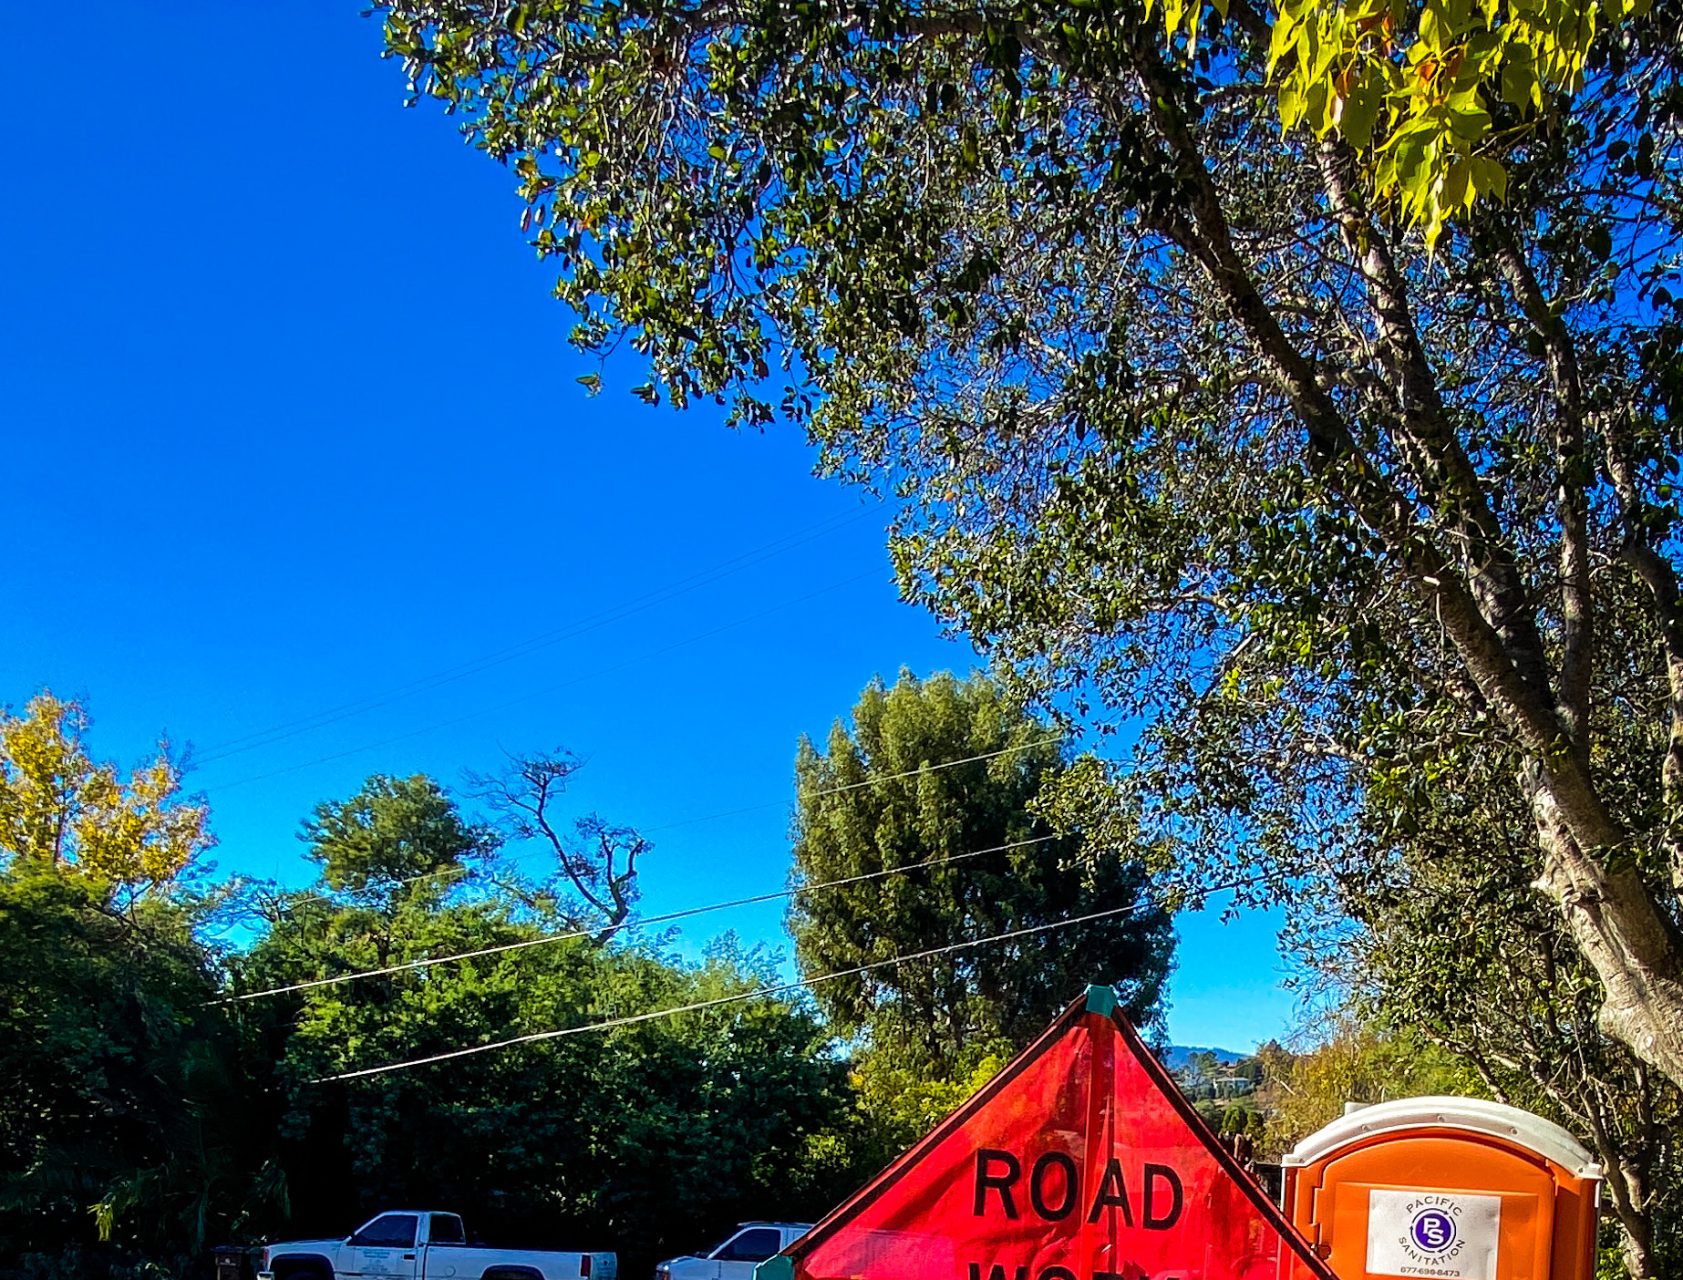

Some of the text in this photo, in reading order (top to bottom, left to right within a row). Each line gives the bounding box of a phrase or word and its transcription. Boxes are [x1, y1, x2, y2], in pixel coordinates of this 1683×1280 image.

[973, 1148, 1184, 1230] ROAD
[1406, 1196, 1462, 1217] PACIFIC
[1399, 1237, 1465, 1265] SANITATION
